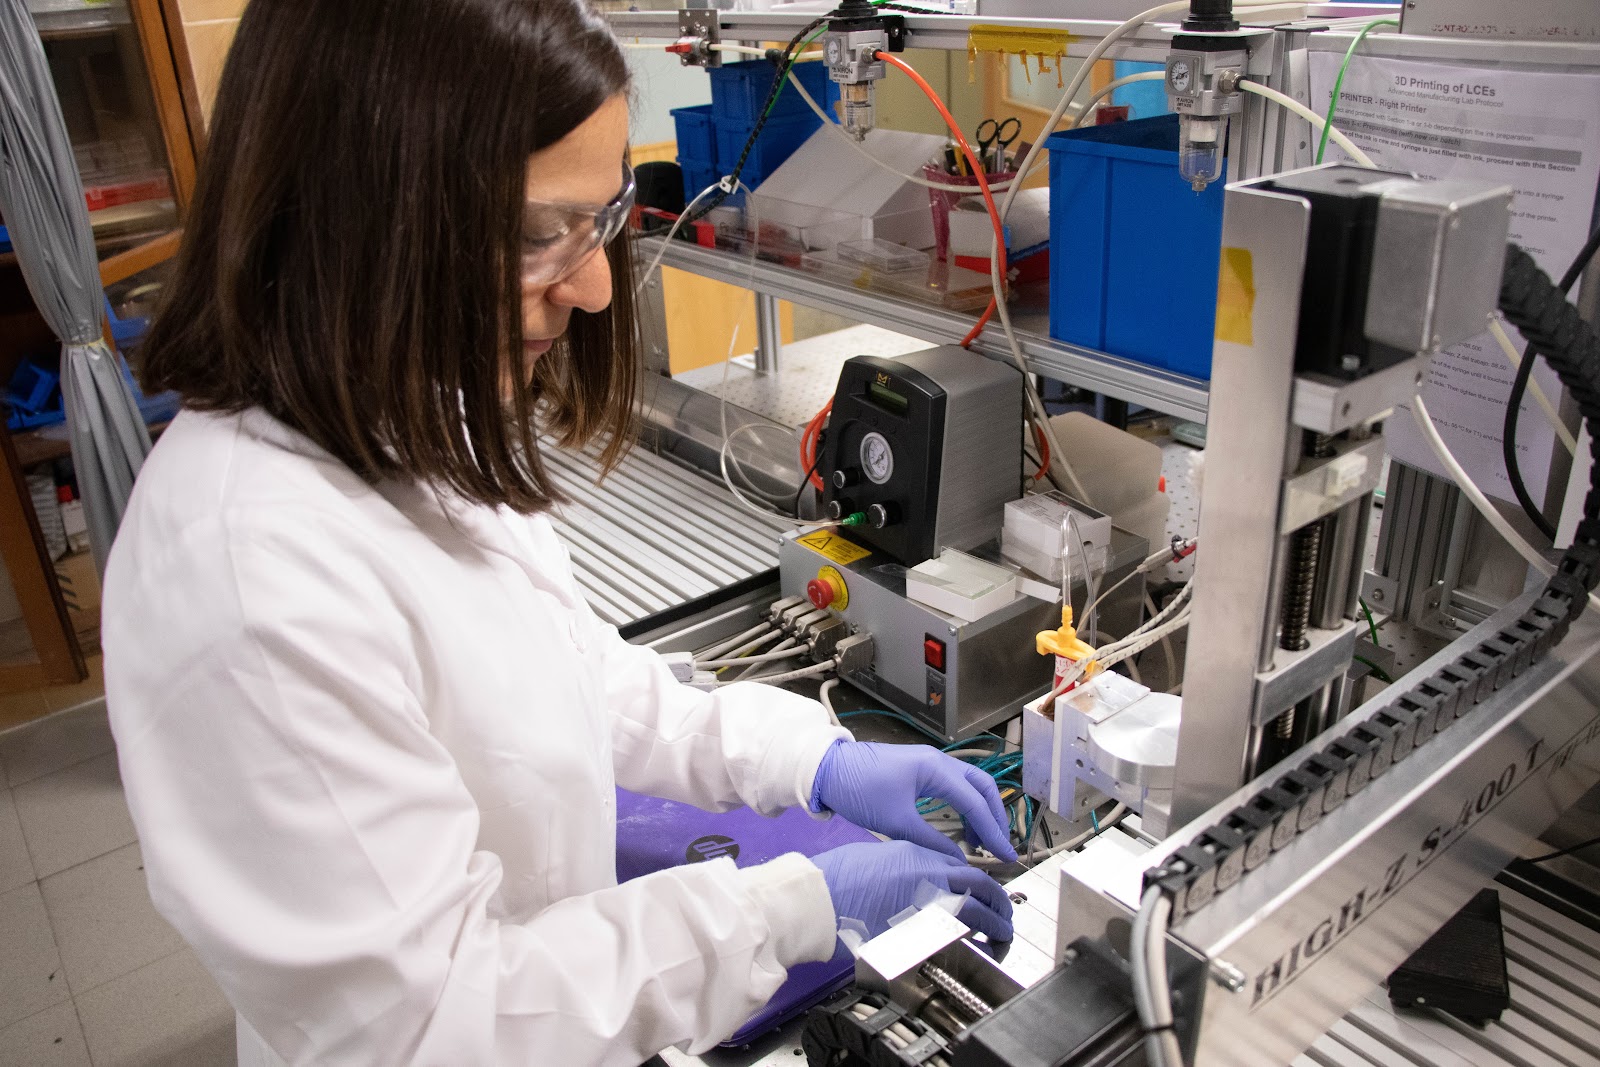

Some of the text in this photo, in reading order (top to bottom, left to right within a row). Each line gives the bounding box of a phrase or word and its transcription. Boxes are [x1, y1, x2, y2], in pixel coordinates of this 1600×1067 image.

[1395, 76, 1496, 96] 3D Printing of LCEs
[1340, 92, 1373, 105] PRINTER
[1380, 99, 1398, 110] Right
[1401, 102, 1427, 113] Printer
[1388, 87, 1415, 98] Advanced
[1416, 92, 1460, 104] Manufacturing
[1476, 98, 1504, 107] Protocol
[1334, 118, 1350, 126] ection
[1363, 122, 1397, 136] Preparations
[1355, 110, 1375, 118] proceed
[1387, 115, 1405, 124] Section
[1434, 124, 1464, 134] depending
[1401, 142, 1421, 152] syringe
[1442, 150, 1457, 158] filled
[1486, 156, 1514, 166] proceed
[1515, 160, 1530, 168] with
[1548, 163, 1576, 172] Section
[1542, 193, 1564, 201] syringe
[1452, 366, 1469, 375] syringe
[1250, 852, 1408, 1006] HIGH-Z
[1416, 763, 1516, 868] S-400
[1526, 738, 1545, 769] T
